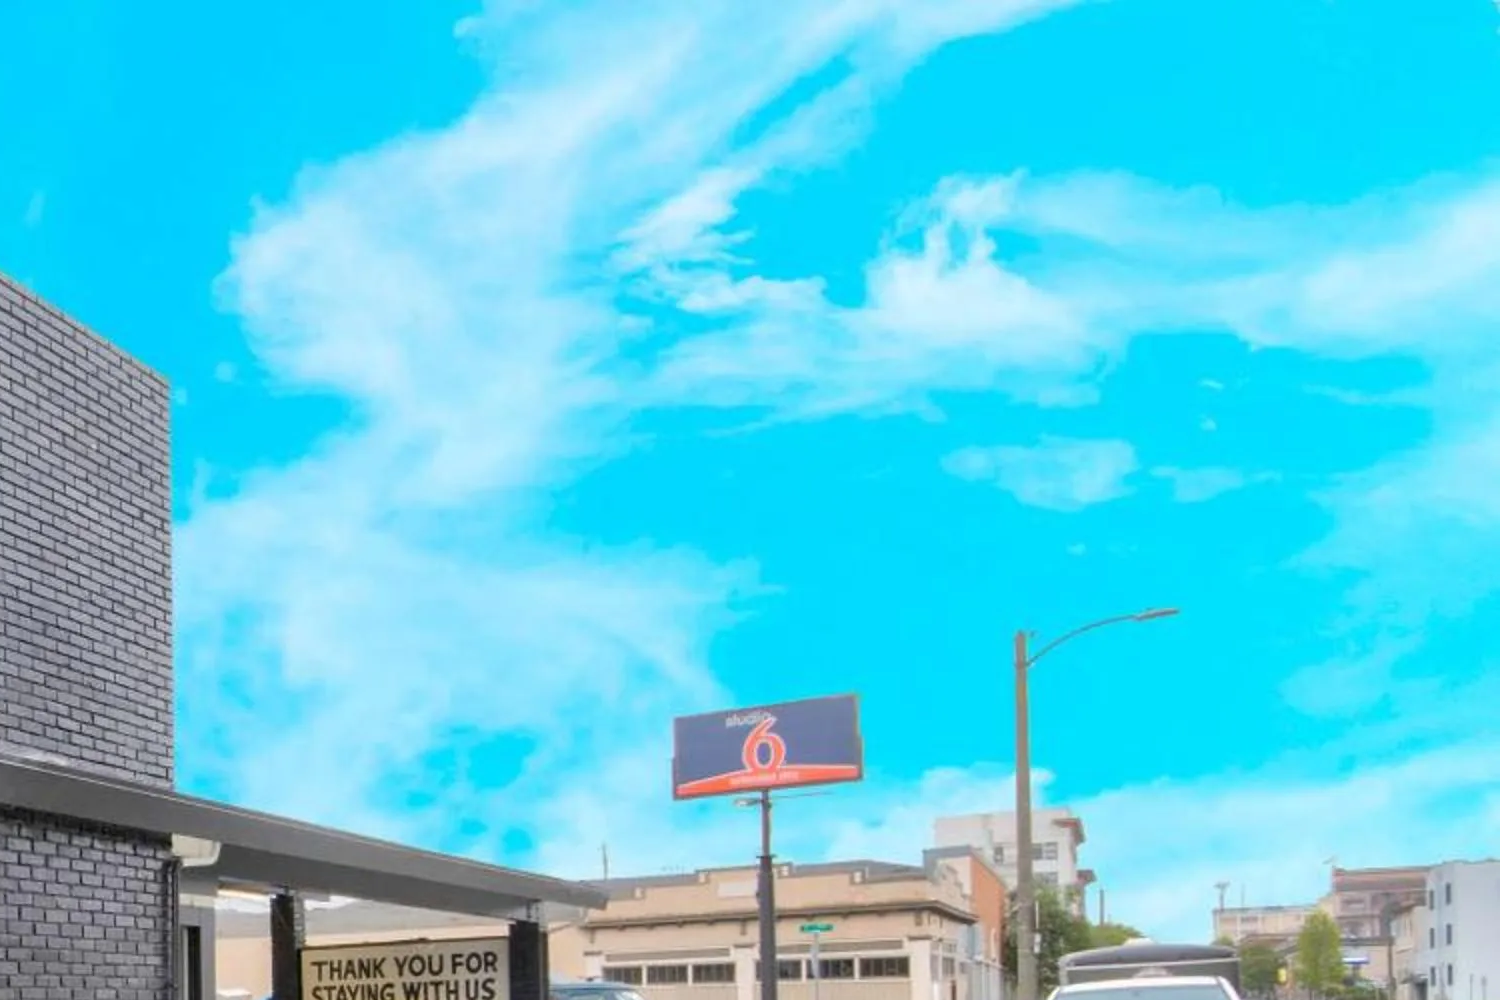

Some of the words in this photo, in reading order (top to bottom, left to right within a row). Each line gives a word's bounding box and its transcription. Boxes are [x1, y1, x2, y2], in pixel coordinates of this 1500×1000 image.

[742, 718, 786, 772] 6
[310, 957, 386, 981] THANK
[394, 954, 444, 977] YOU
[451, 951, 498, 975] FOR
